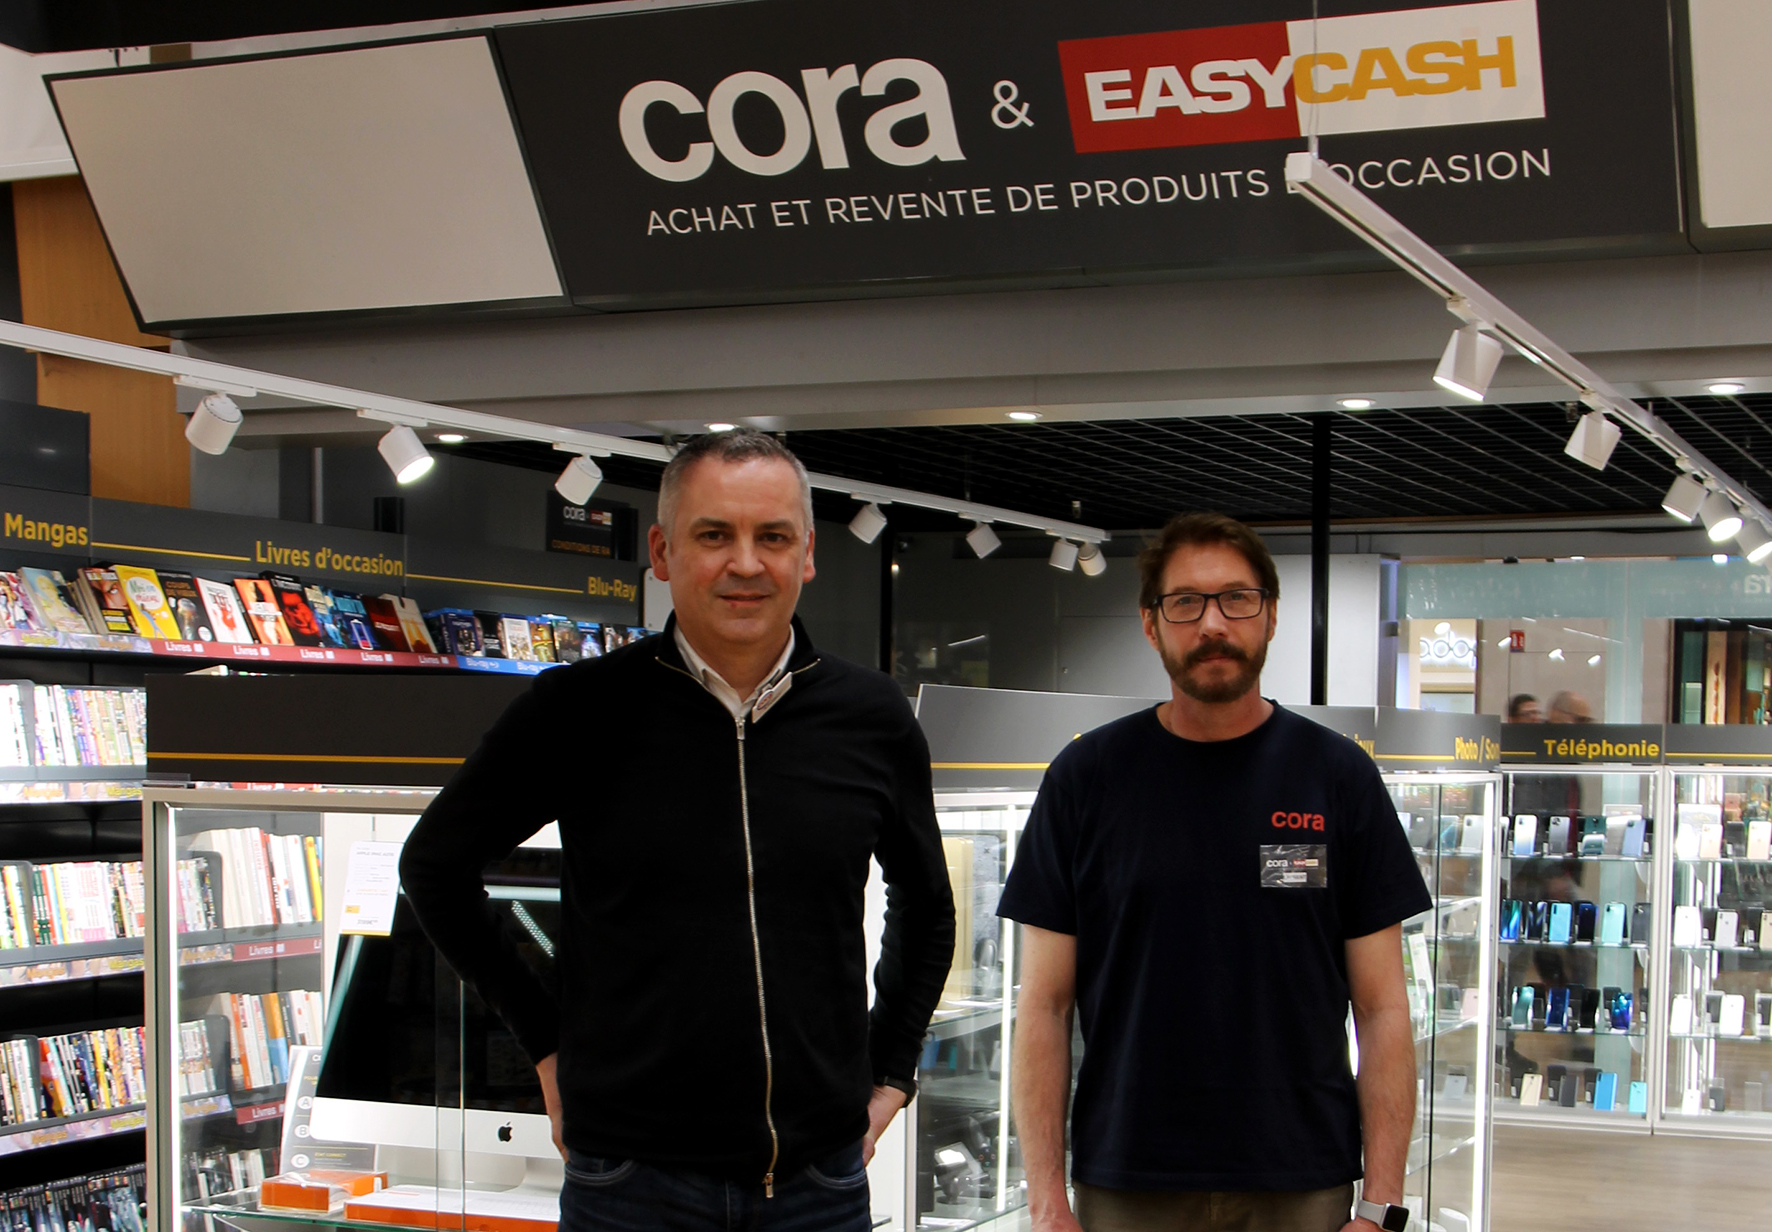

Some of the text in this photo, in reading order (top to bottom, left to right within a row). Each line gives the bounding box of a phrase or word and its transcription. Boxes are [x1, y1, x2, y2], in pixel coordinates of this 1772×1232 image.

[618, 35, 1518, 183] cora & EASYCASH
[646, 203, 758, 236] ACHAT
[770, 199, 812, 228] ET
[826, 187, 996, 225] REVENTE
[1006, 183, 1060, 213] DE
[1070, 168, 1271, 209] PRODUITS
[562, 505, 586, 521] cora
[4, 512, 88, 548] Mangas
[255, 540, 310, 568] Livres
[587, 576, 638, 601] Blu-Ray
[165, 641, 193, 652] Livres
[233, 645, 259, 656] Livres
[300, 649, 324, 660] Livres
[361, 652, 384, 662] Livres
[418, 655, 440, 665] Livres
[1455, 736, 1479, 760] Photo
[1543, 738, 1660, 760] Téléphonie
[106, 786, 143, 798] Mangas
[1271, 811, 1326, 831] cora
[1265, 859, 1288, 868] cora
[249, 945, 274, 956] Livres
[109, 958, 144, 971] Mangas
[252, 1106, 277, 1118] Livres
